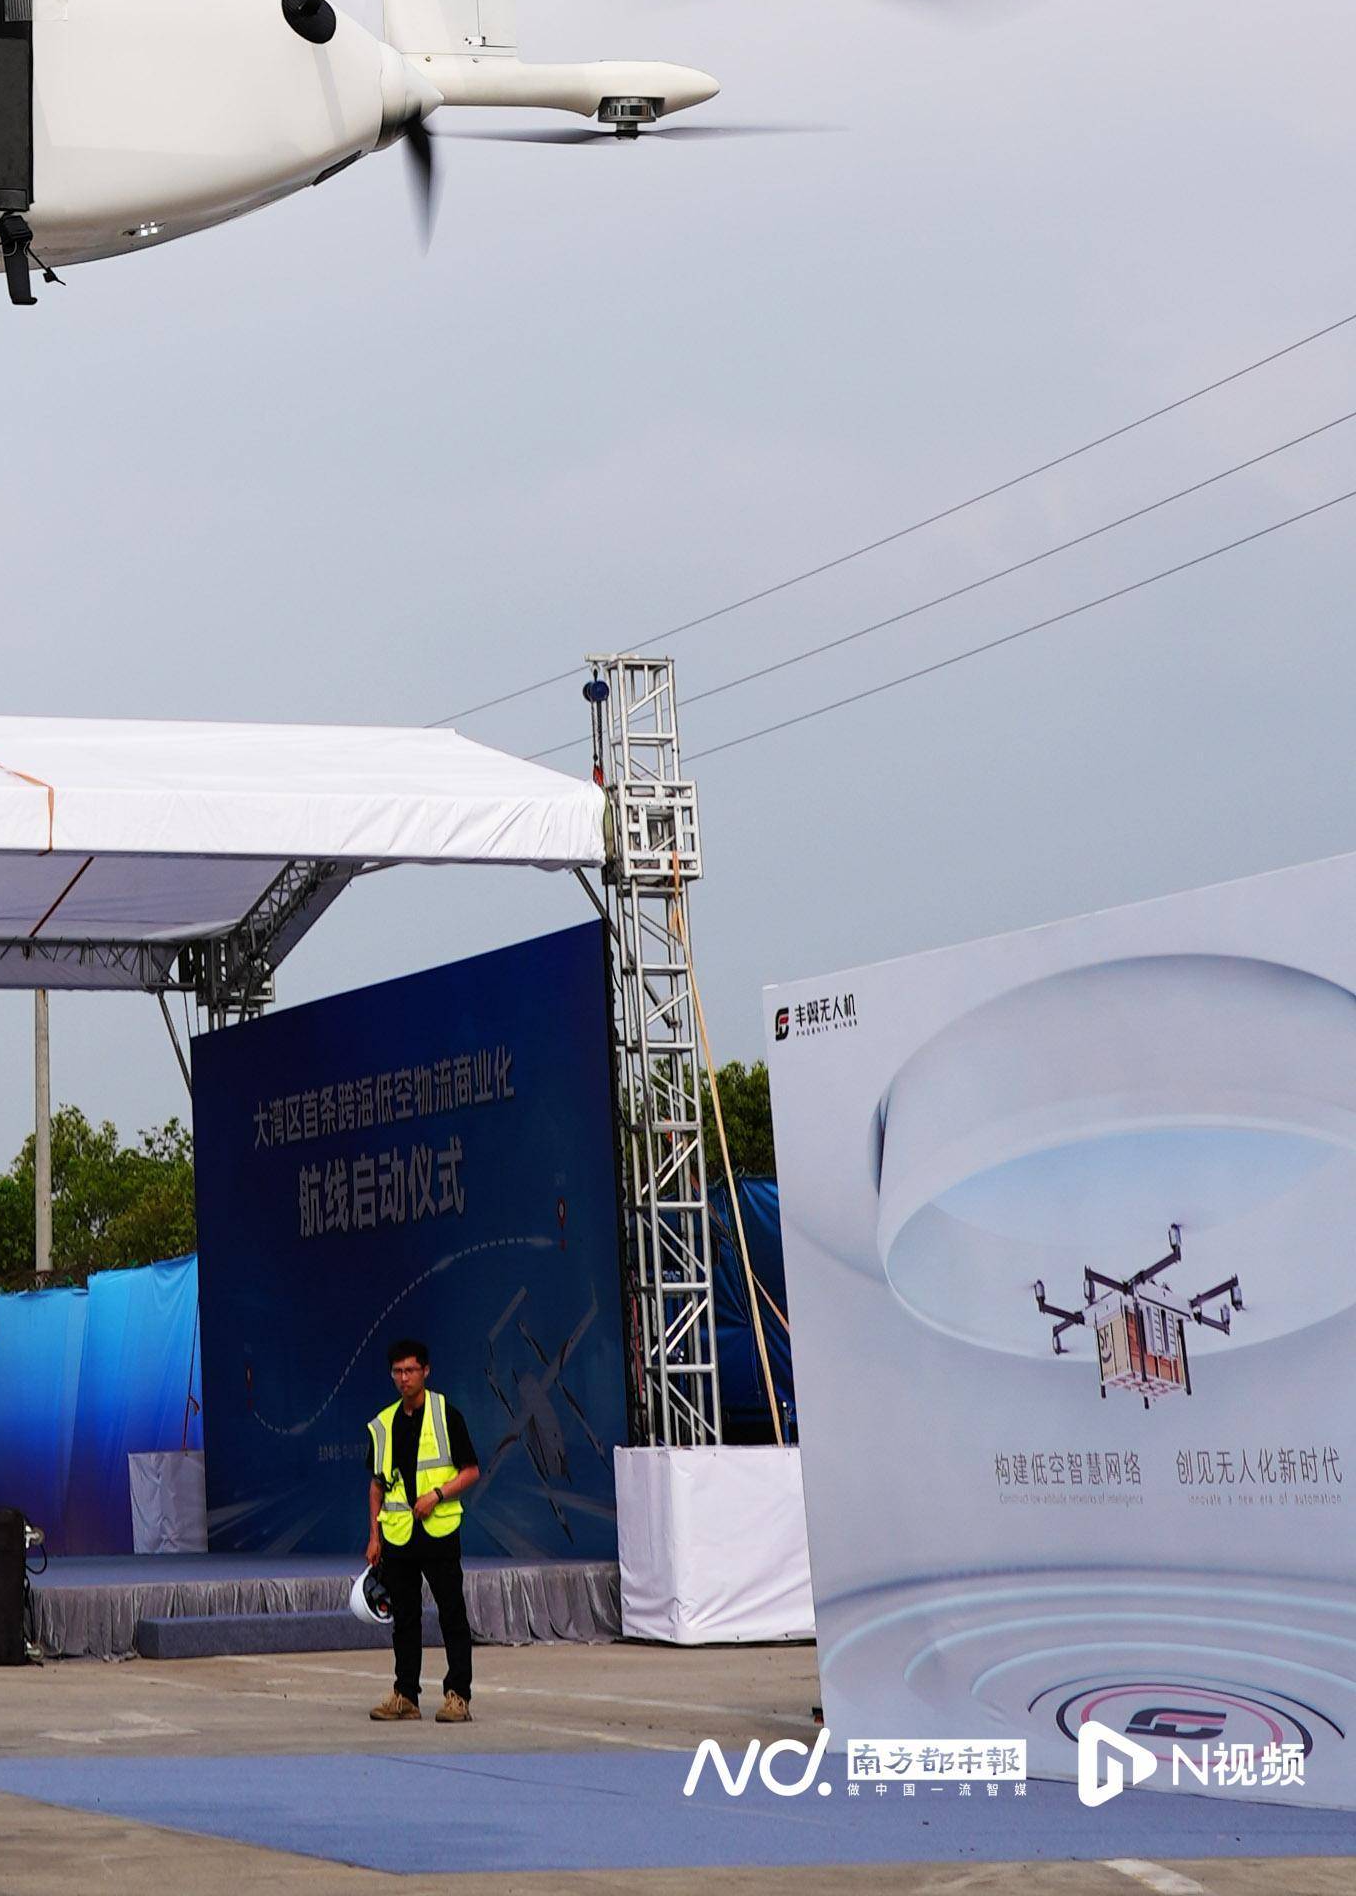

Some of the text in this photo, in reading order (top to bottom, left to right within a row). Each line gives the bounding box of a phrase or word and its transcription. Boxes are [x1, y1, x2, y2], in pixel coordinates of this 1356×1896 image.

[794, 993, 856, 1028] 丰翼无人机
[252, 1044, 515, 1151] 大湾区首条跨海低空物流商业化
[298, 1134, 465, 1239] 航线启动仪式
[994, 1446, 1343, 1486] 构建低空智慧网络 创见无人化新时代
